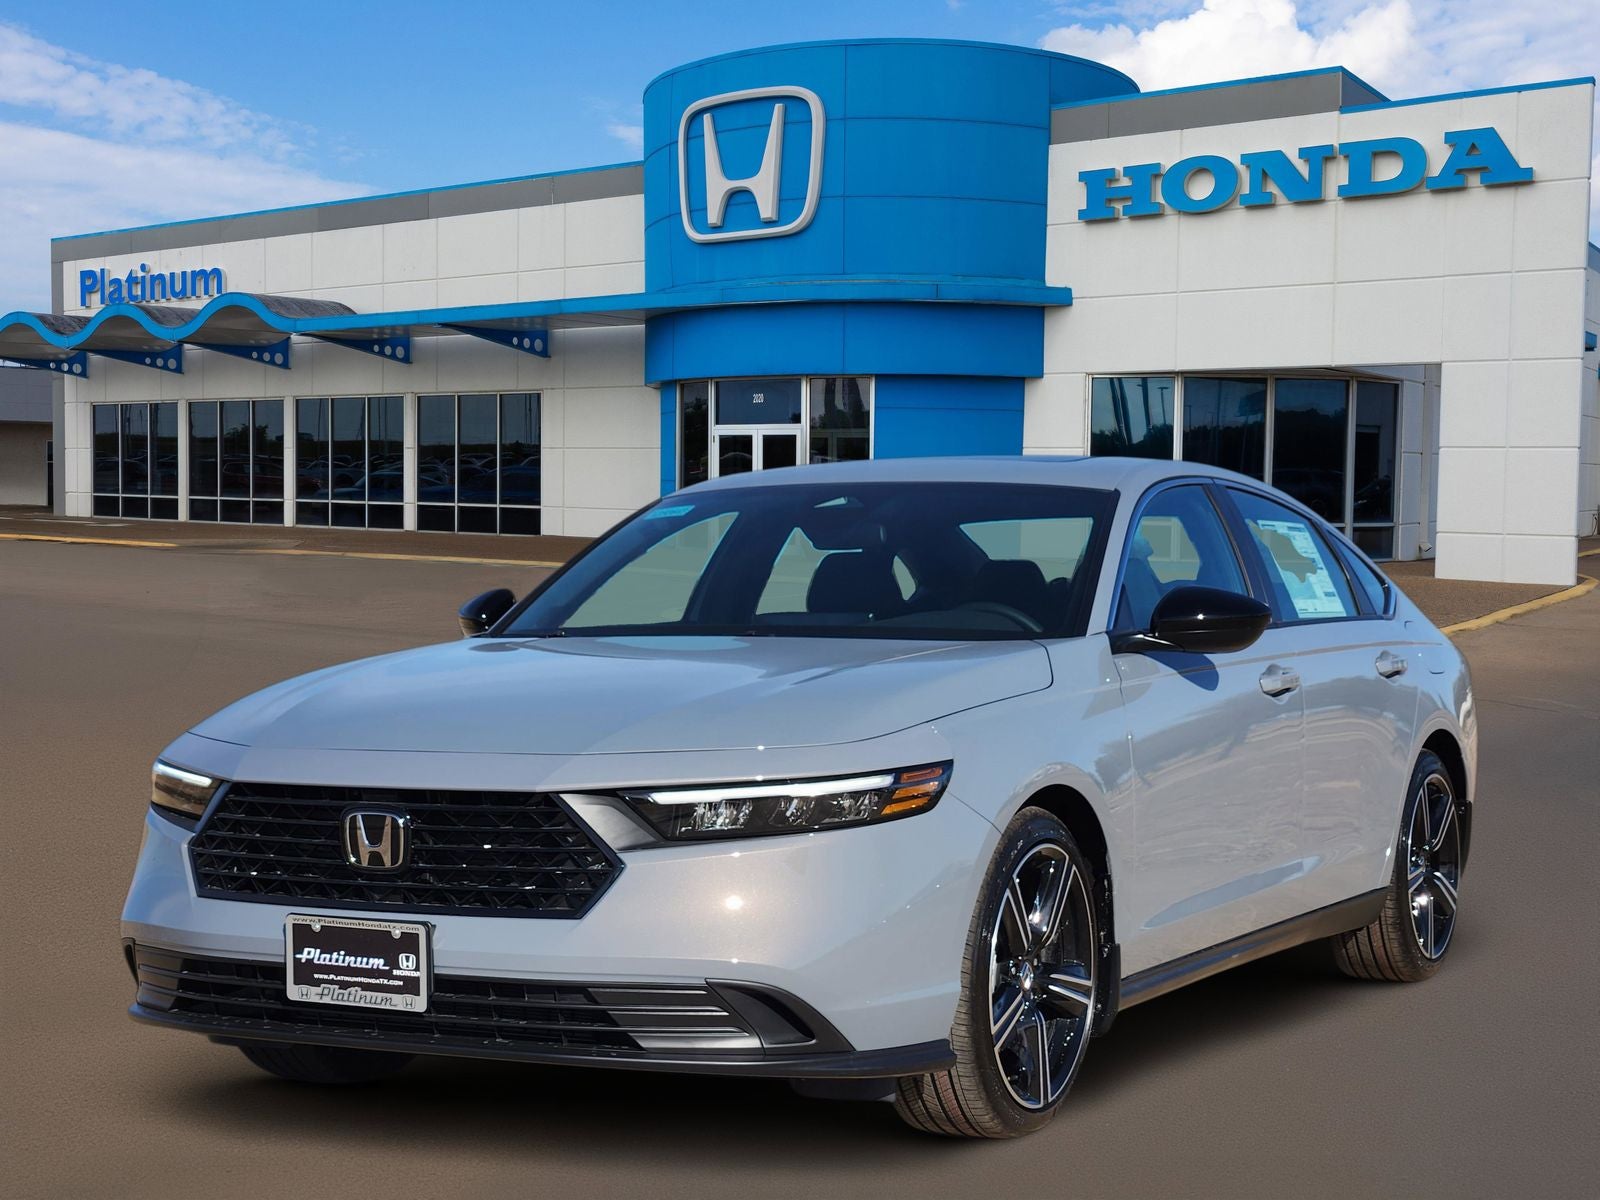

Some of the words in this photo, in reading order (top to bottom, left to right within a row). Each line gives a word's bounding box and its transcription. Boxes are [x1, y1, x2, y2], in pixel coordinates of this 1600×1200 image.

[1078, 127, 1533, 221] HONDA
[80, 263, 226, 307] Platinum
[295, 947, 390, 970] Platinum
[315, 984, 399, 1007] Platinum
